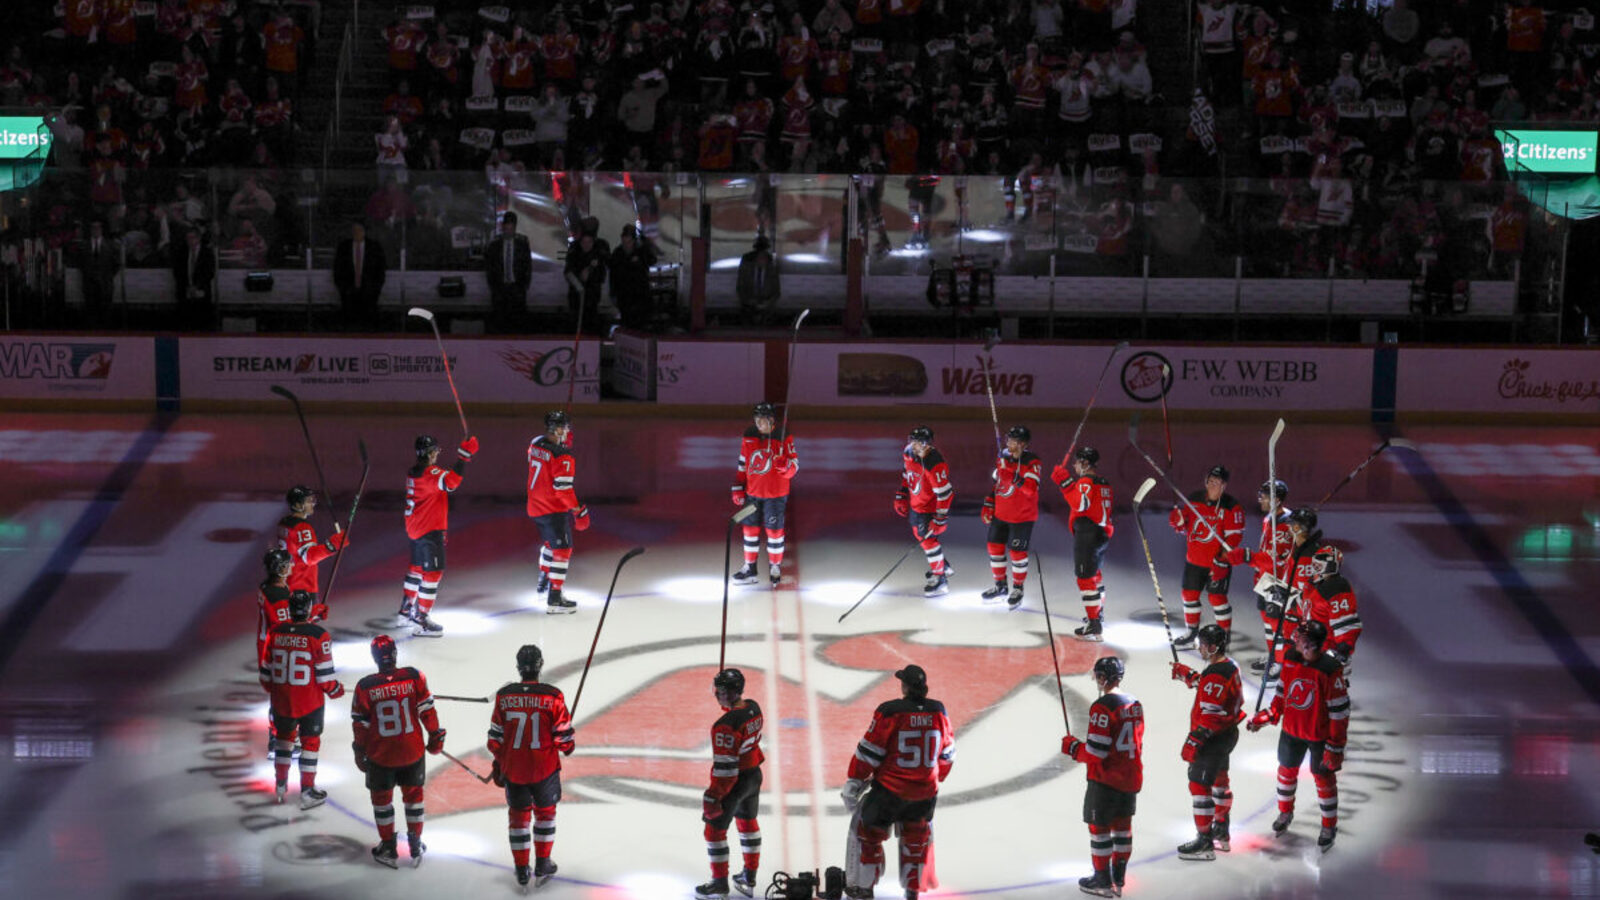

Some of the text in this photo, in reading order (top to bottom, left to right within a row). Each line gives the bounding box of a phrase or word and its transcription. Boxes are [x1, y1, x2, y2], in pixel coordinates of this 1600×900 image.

[1518, 143, 1586, 160] Citizens
[213, 357, 359, 372] STREAM LIVE
[394, 356, 457, 365] THE GOTHM
[1182, 359, 1318, 382] F.W. WEBB
[942, 367, 1034, 396] Wawa
[1210, 385, 1289, 398] COMPANY
[531, 459, 542, 490] 7
[562, 461, 571, 473] 7
[934, 470, 946, 483] 14
[297, 529, 312, 543] 13
[1296, 564, 1314, 578] 28
[1330, 599, 1350, 614] 34
[274, 635, 308, 649] HUGHES
[271, 648, 312, 687] 86
[369, 681, 415, 701] GRITSYUK
[1202, 682, 1224, 698] 47
[375, 697, 415, 738] 81
[910, 715, 933, 728] DAWS
[1089, 712, 1109, 728] 48
[505, 711, 541, 750] 71
[715, 732, 735, 749] 63
[1115, 720, 1142, 759] 4
[896, 729, 942, 768] 50
